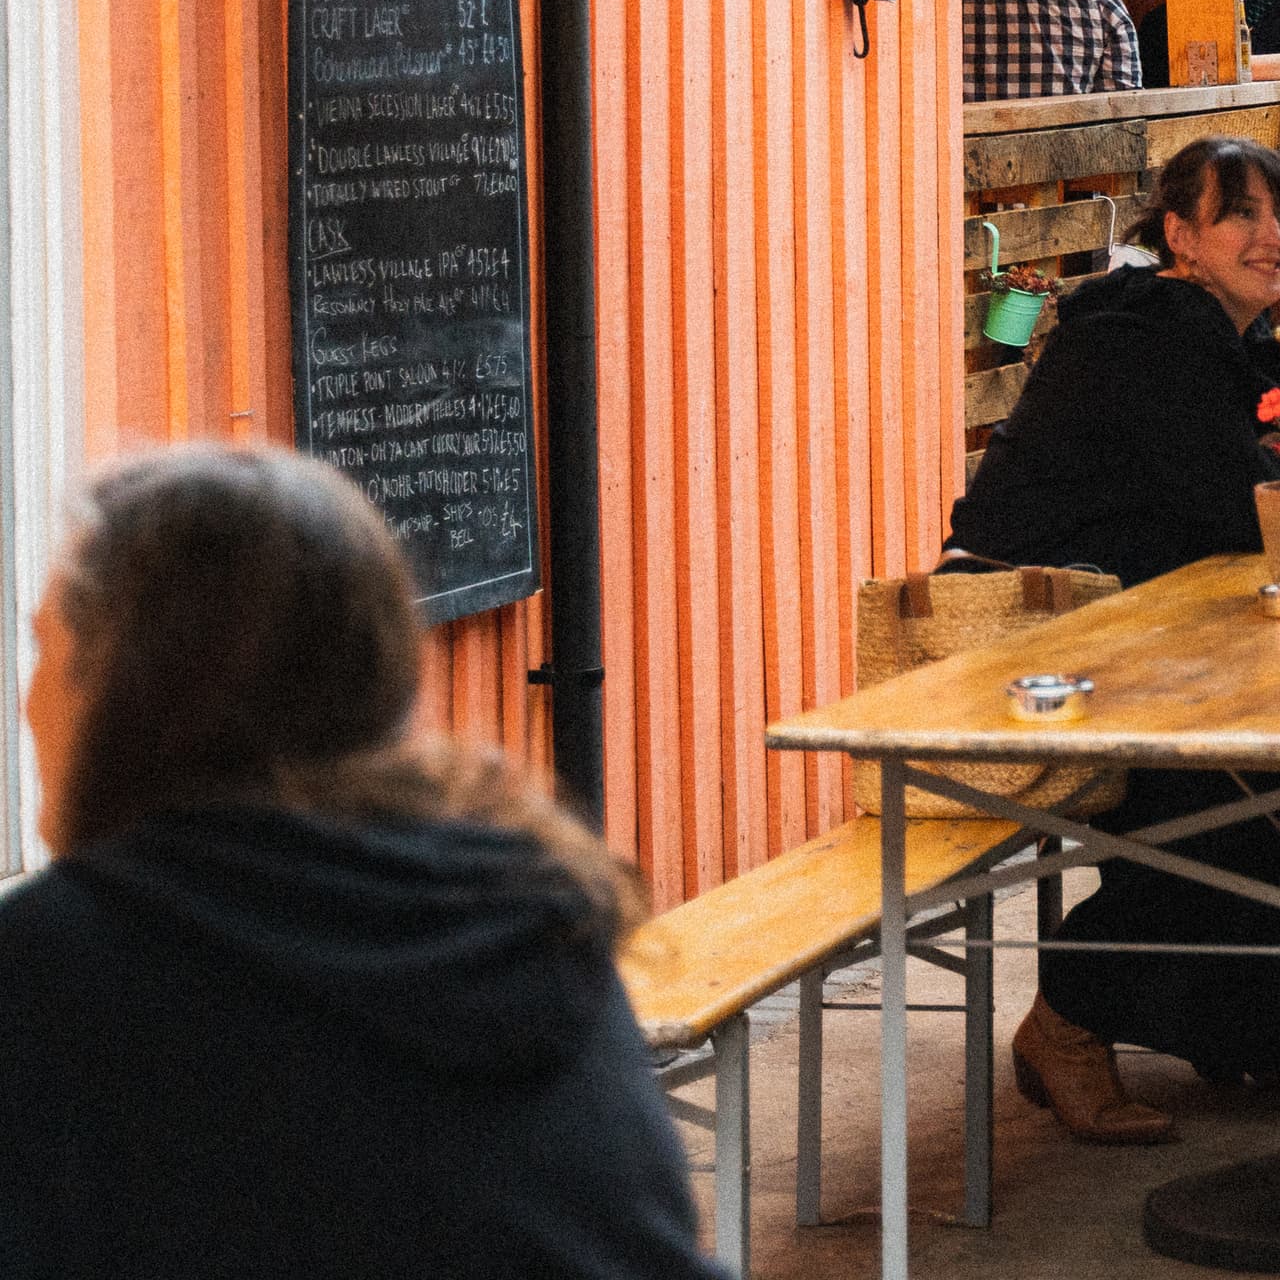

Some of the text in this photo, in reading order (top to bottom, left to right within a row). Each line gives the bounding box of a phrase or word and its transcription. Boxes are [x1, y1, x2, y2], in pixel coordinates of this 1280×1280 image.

[311, 6, 357, 40] CRAFT
[365, 6, 403, 38] LAGER
[316, 97, 363, 127] VIENNA
[368, 92, 423, 121] SECESSION
[426, 92, 456, 119] LAGER
[318, 143, 372, 174] DOUBLE
[376, 143, 425, 167] LAWLESS
[429, 140, 470, 164] VILLAGE
[312, 178, 367, 208] TOTALLY
[371, 177, 410, 200] WIRED
[414, 176, 448, 199] STOUT
[308, 219, 350, 254] CASK
[313, 258, 376, 288] LAWLESS
[379, 257, 433, 280] VILLAGE
[315, 371, 359, 402] TRIPLE
[363, 369, 392, 394] POINT
[316, 406, 377, 439] TEMPEST
[384, 401, 430, 429] MODERN
[370, 440, 387, 462] OH
[449, 528, 475, 552] BELL
